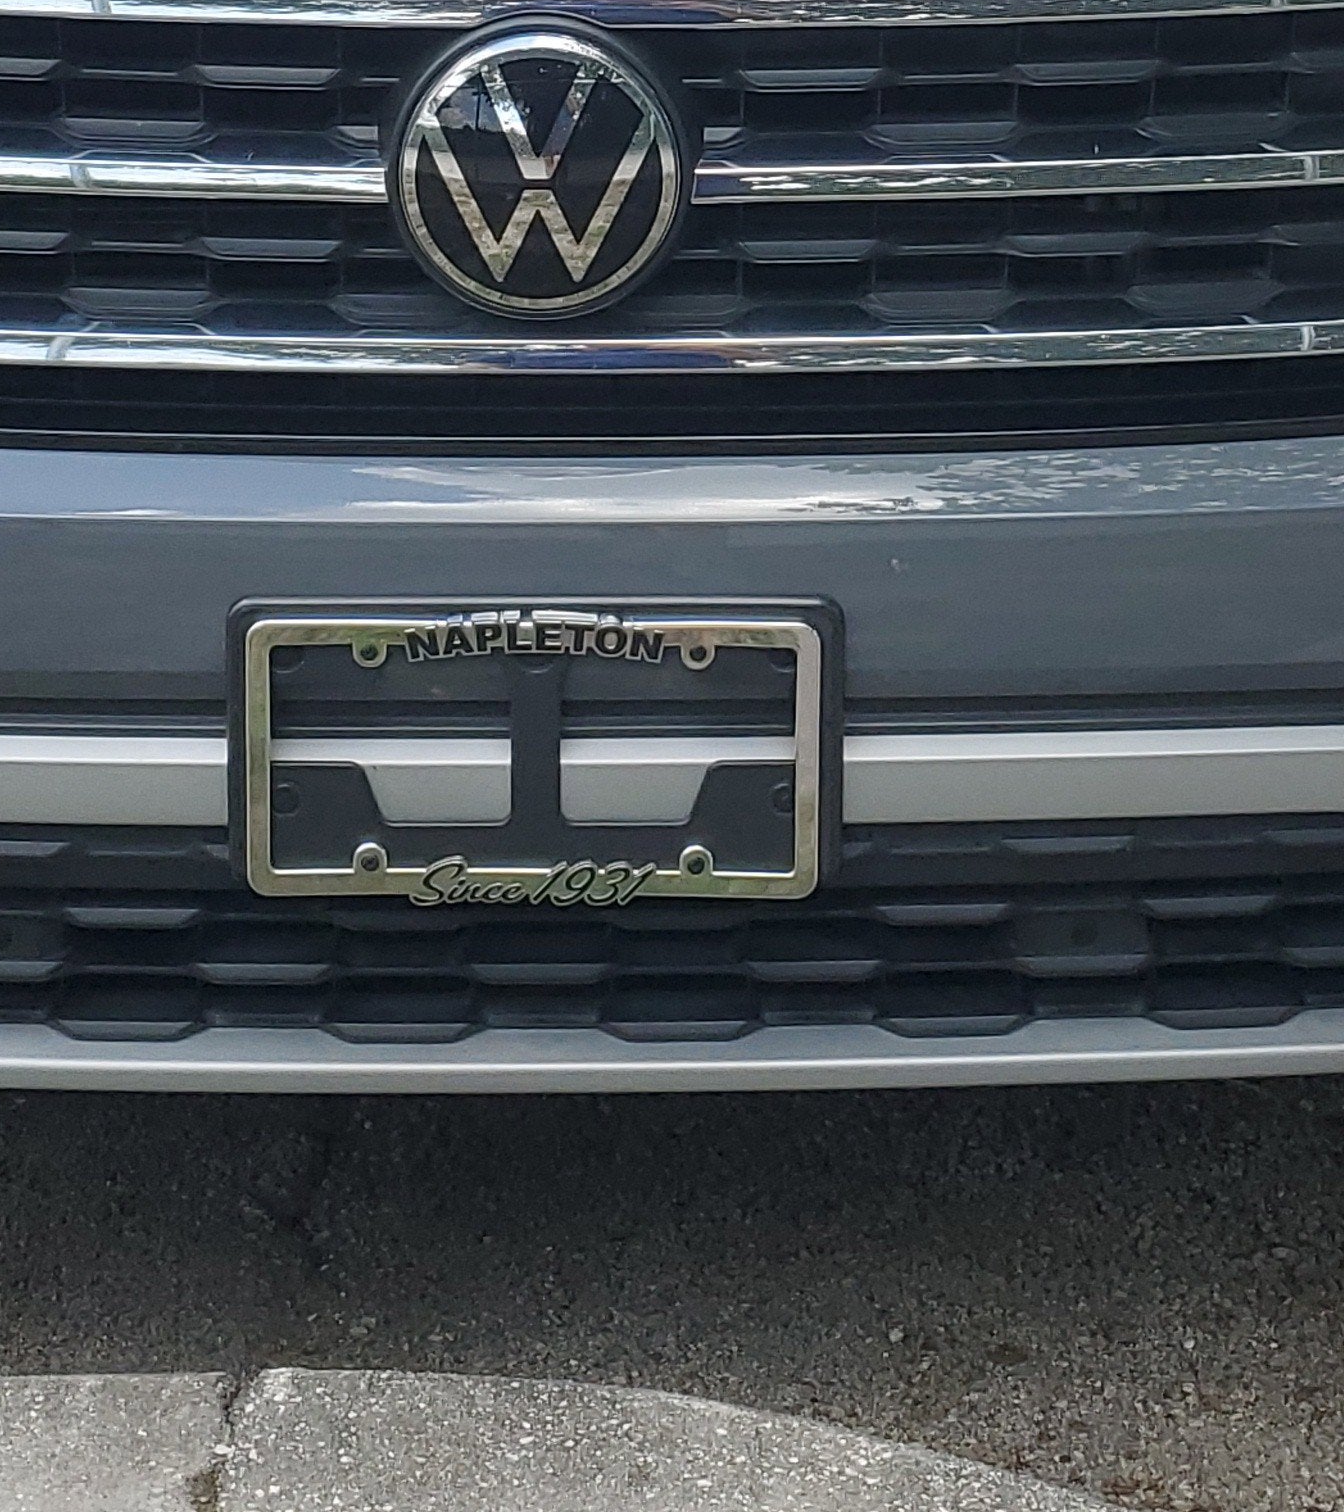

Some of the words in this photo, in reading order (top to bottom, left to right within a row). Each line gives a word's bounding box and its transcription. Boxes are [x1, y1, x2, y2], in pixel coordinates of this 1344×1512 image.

[404, 611, 666, 663] NAPLETON
[409, 855, 527, 906] Since
[528, 859, 656, 907] 1931
